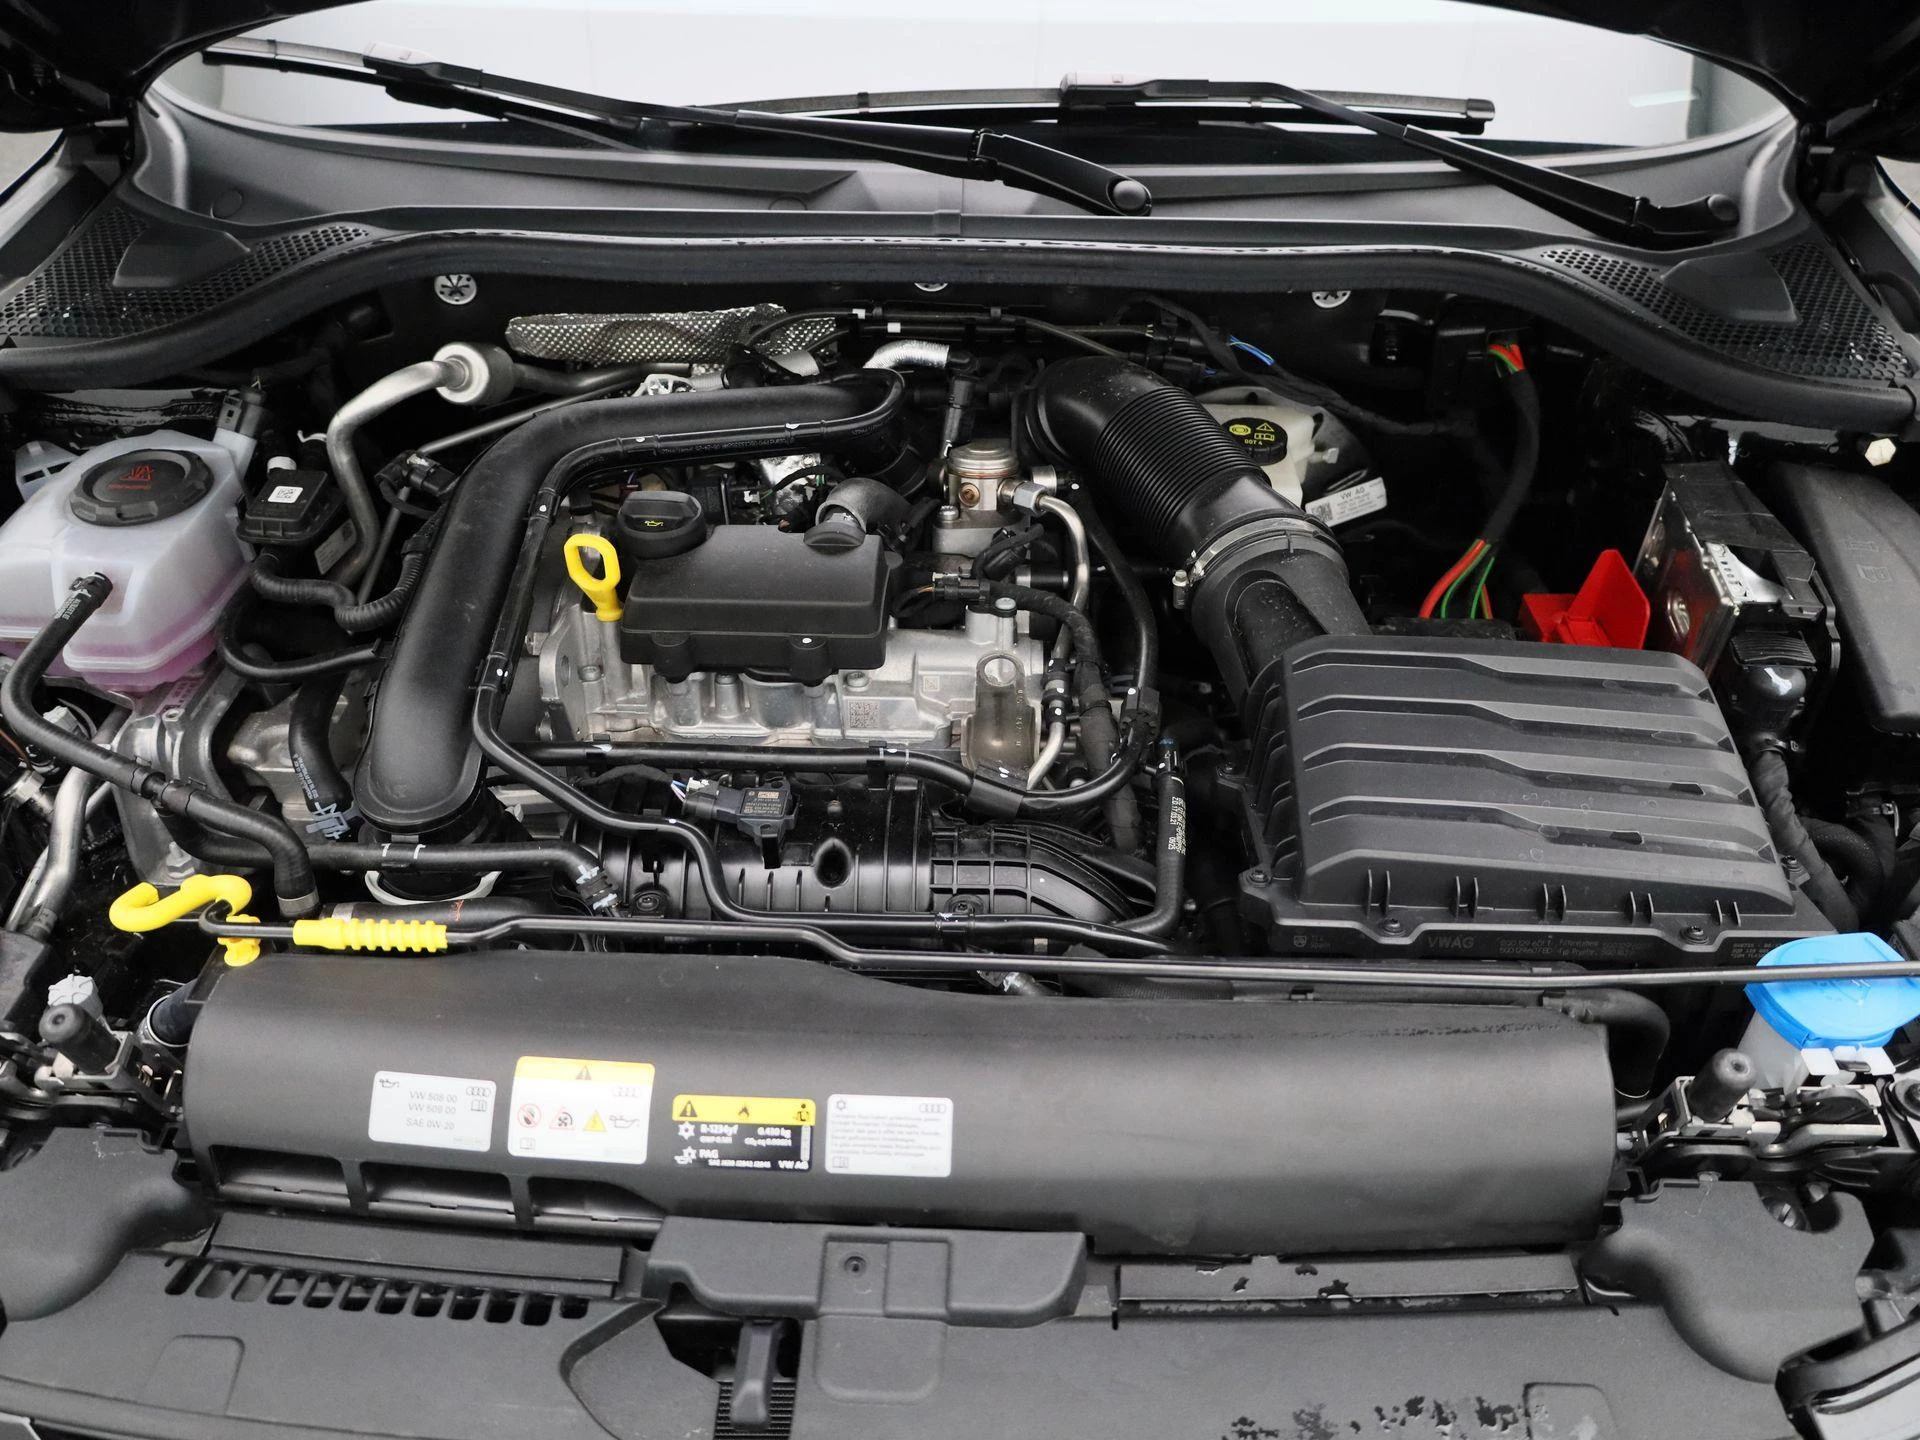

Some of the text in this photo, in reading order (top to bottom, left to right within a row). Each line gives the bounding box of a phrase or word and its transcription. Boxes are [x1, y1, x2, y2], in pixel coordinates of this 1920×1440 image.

[409, 1090, 426, 1101] VW
[446, 1094, 458, 1104] 00
[408, 1103, 424, 1112] VW
[445, 1105, 457, 1114] 00
[405, 1118, 425, 1128] SAE
[777, 1160, 794, 1169] VW
